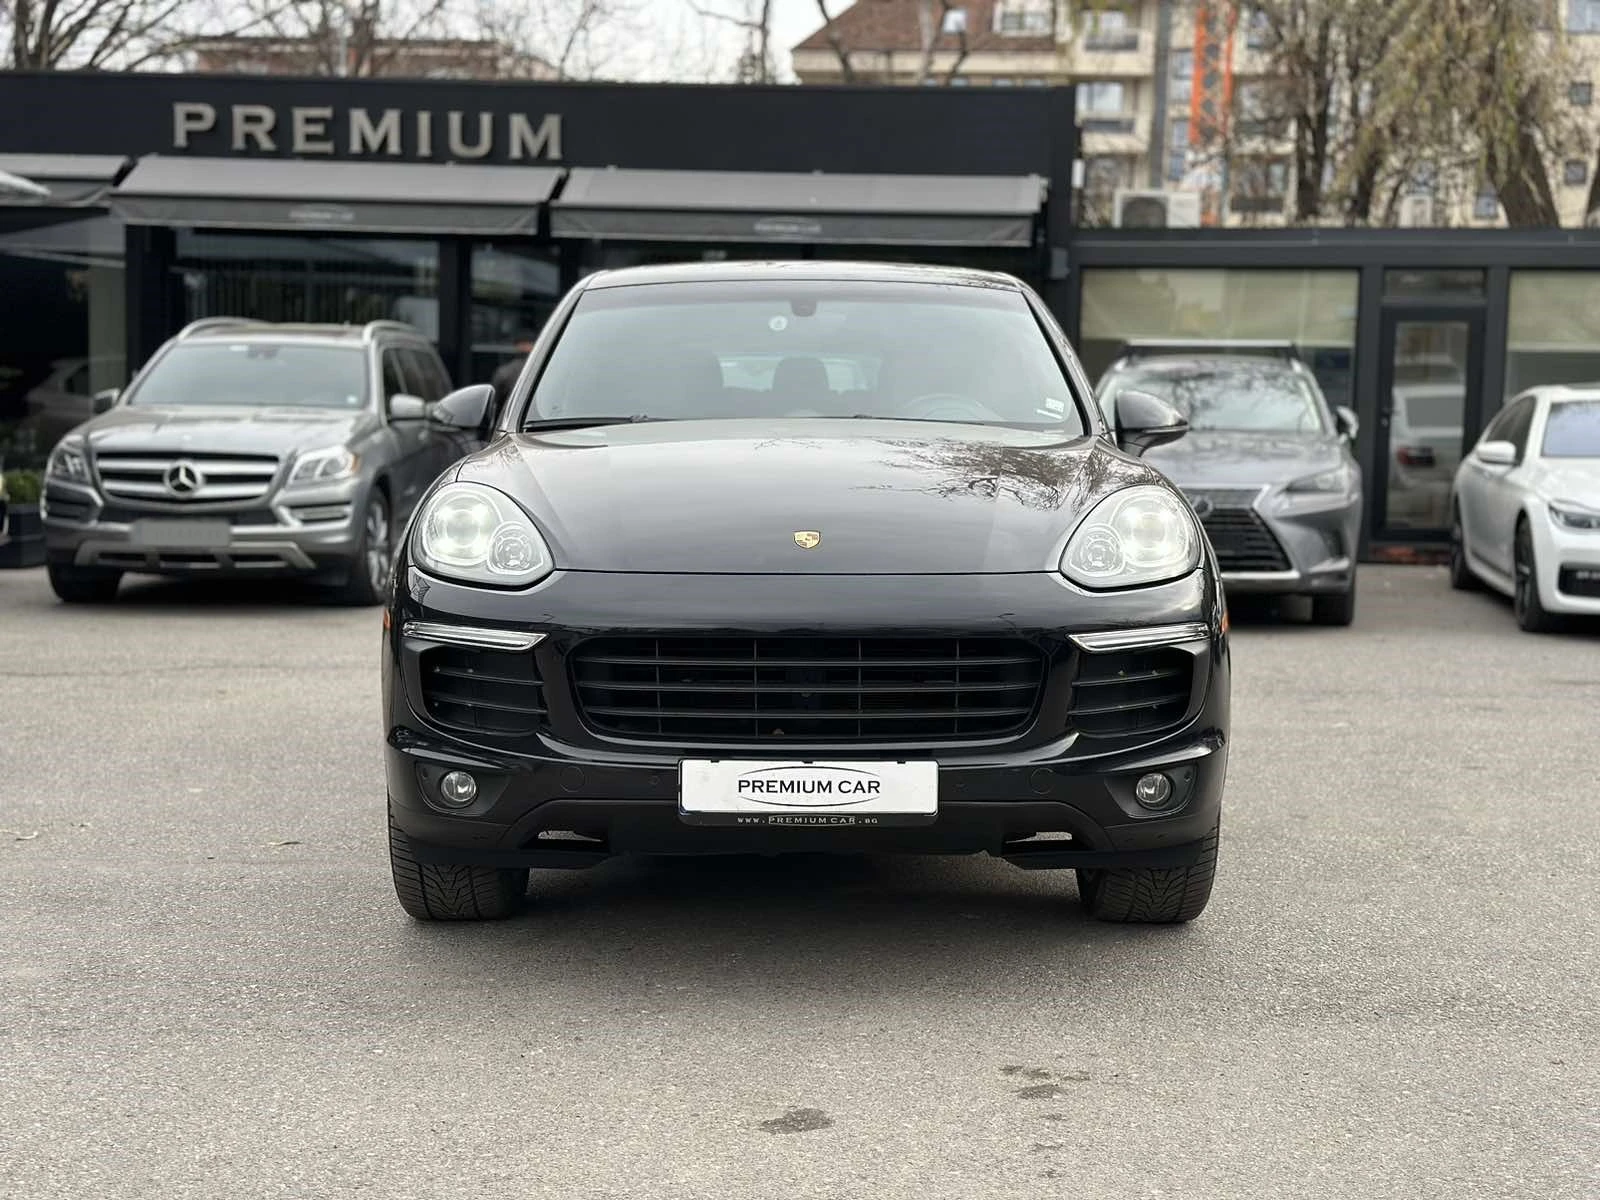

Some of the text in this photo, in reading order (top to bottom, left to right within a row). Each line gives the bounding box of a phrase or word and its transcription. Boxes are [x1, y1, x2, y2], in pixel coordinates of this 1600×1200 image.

[173, 102, 563, 160] PREMIUM
[738, 780, 880, 794] PREMIUM CAR
